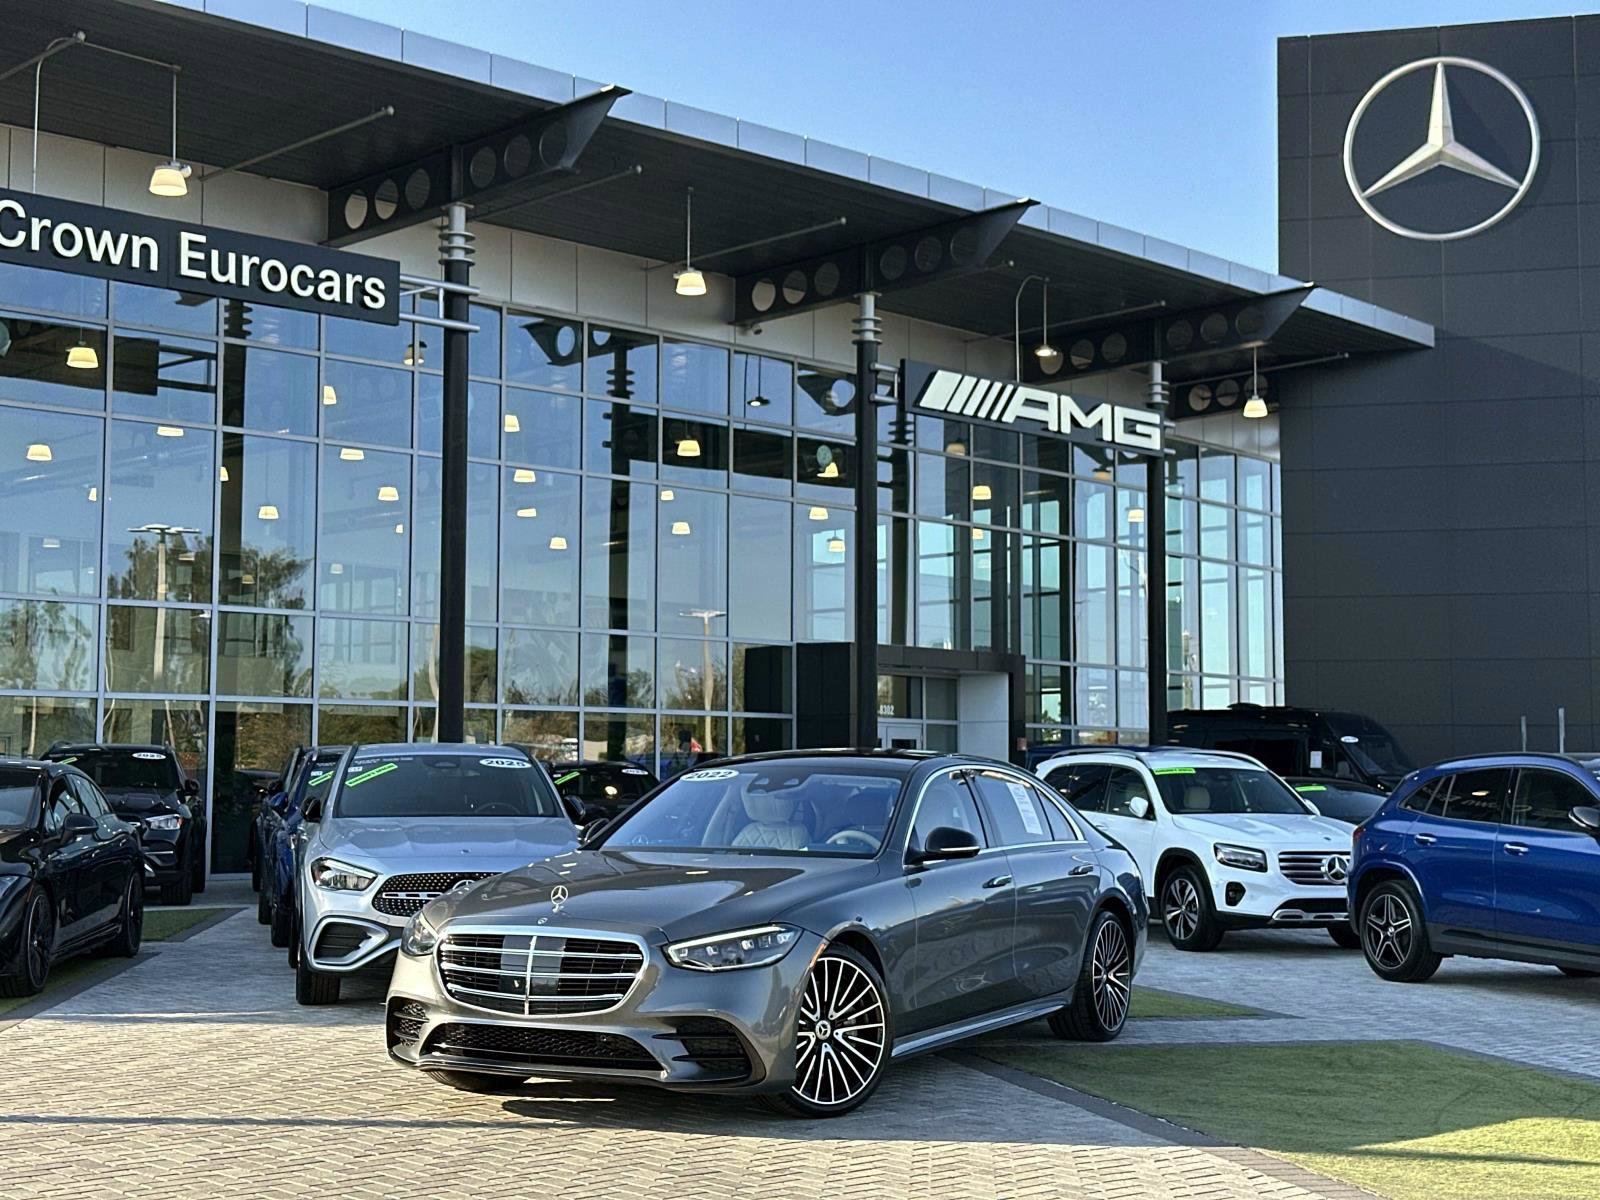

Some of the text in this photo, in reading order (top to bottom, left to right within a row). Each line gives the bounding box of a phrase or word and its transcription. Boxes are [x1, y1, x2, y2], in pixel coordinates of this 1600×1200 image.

[0, 199, 386, 310] Crown Eurocars
[1001, 385, 1161, 450] AMG
[485, 759, 526, 767] 2025
[684, 771, 733, 779] 2022
